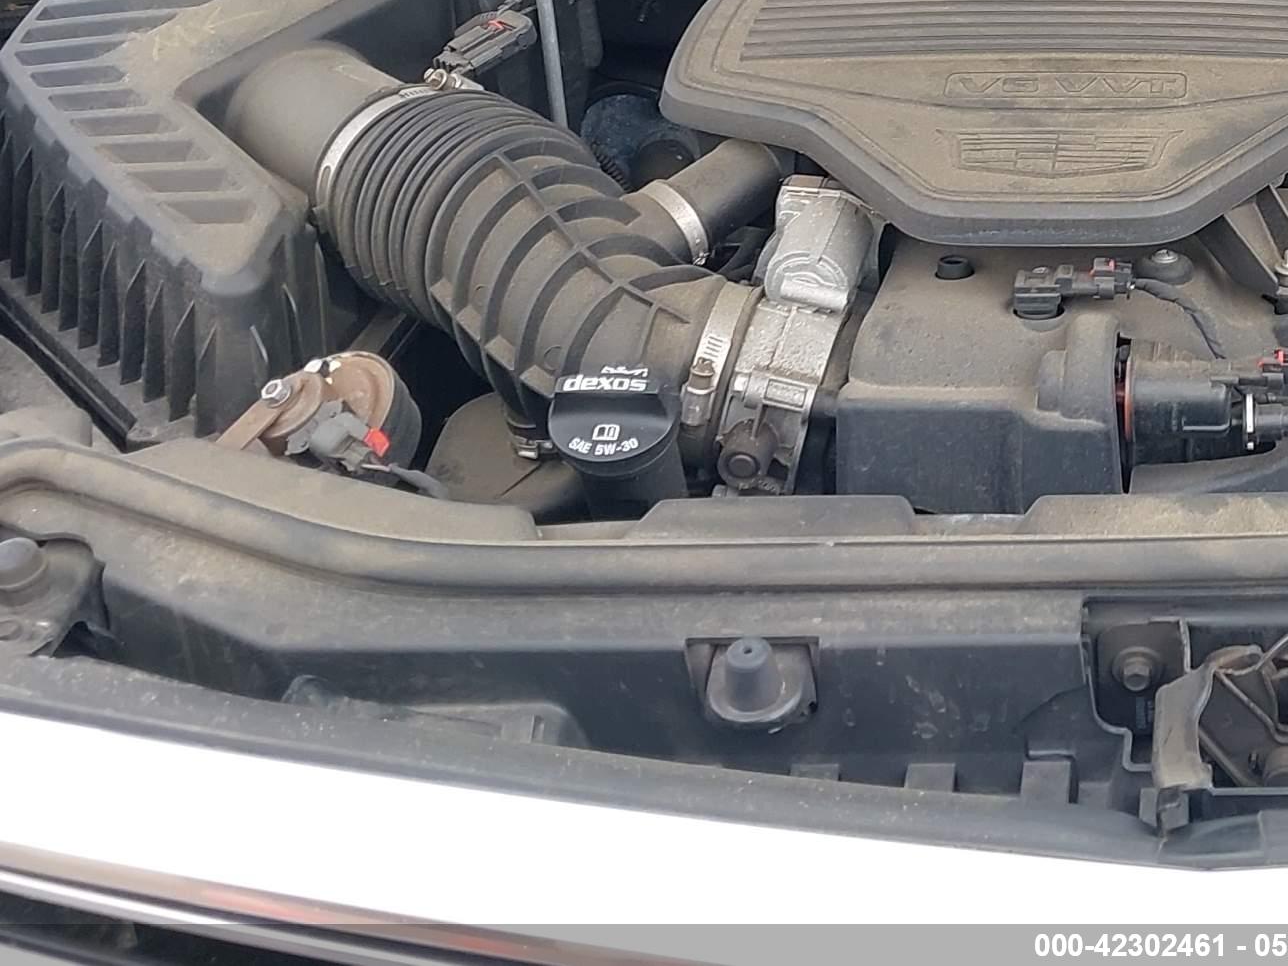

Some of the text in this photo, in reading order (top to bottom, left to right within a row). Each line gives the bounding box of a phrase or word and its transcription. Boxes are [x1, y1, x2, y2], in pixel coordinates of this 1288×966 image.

[563, 374, 650, 392] dexos
[568, 437, 639, 456] SAE 5W-30
